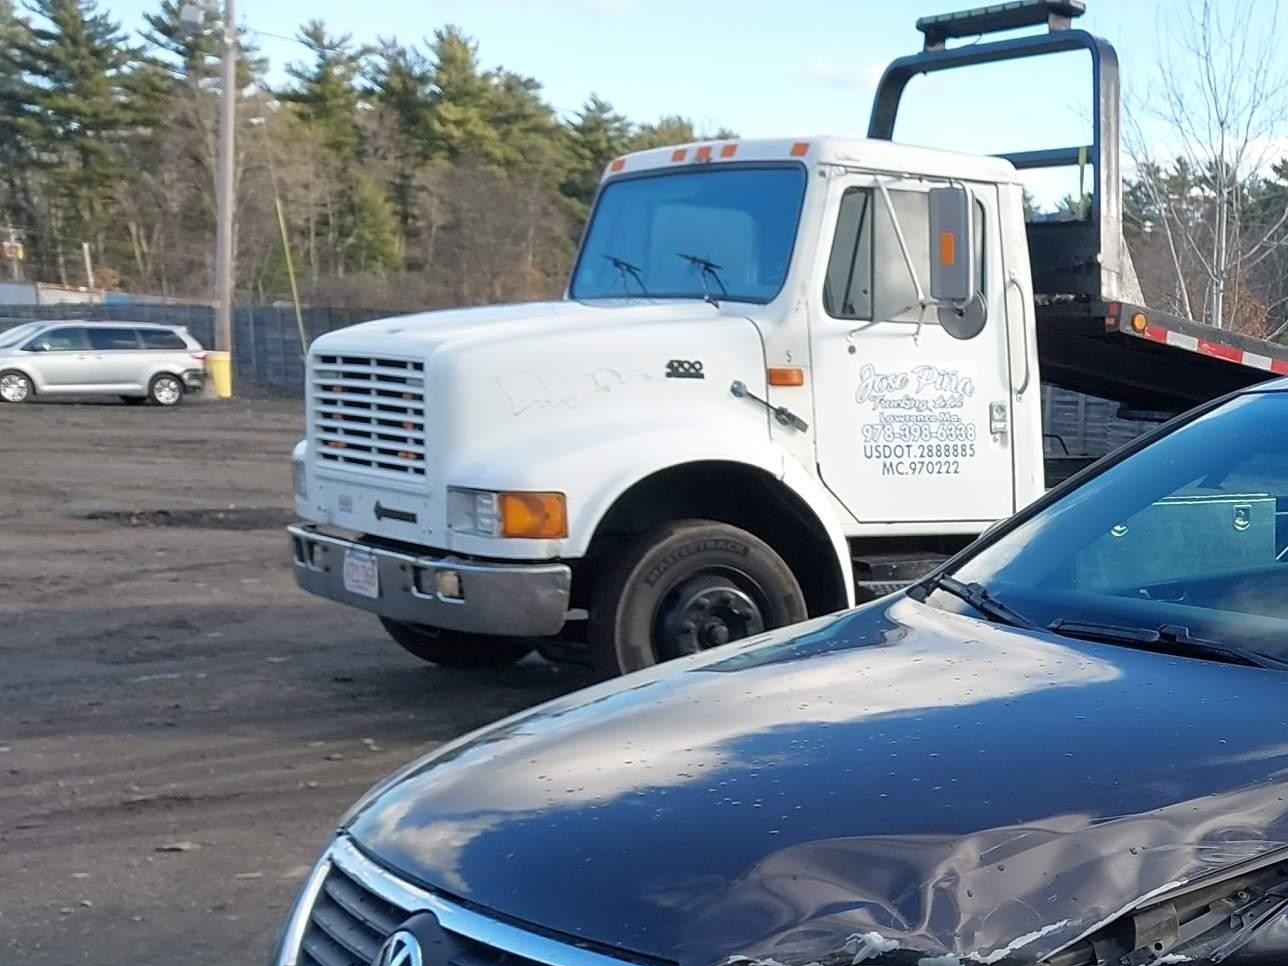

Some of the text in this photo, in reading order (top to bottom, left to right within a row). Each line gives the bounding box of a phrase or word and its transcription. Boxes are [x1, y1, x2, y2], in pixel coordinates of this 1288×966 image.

[665, 359, 704, 375] 4700
[855, 363, 910, 404] Jose
[862, 423, 976, 442] 978-398-6338
[863, 444, 976, 459] USDOT.2888885
[881, 461, 961, 476] MC.970222
